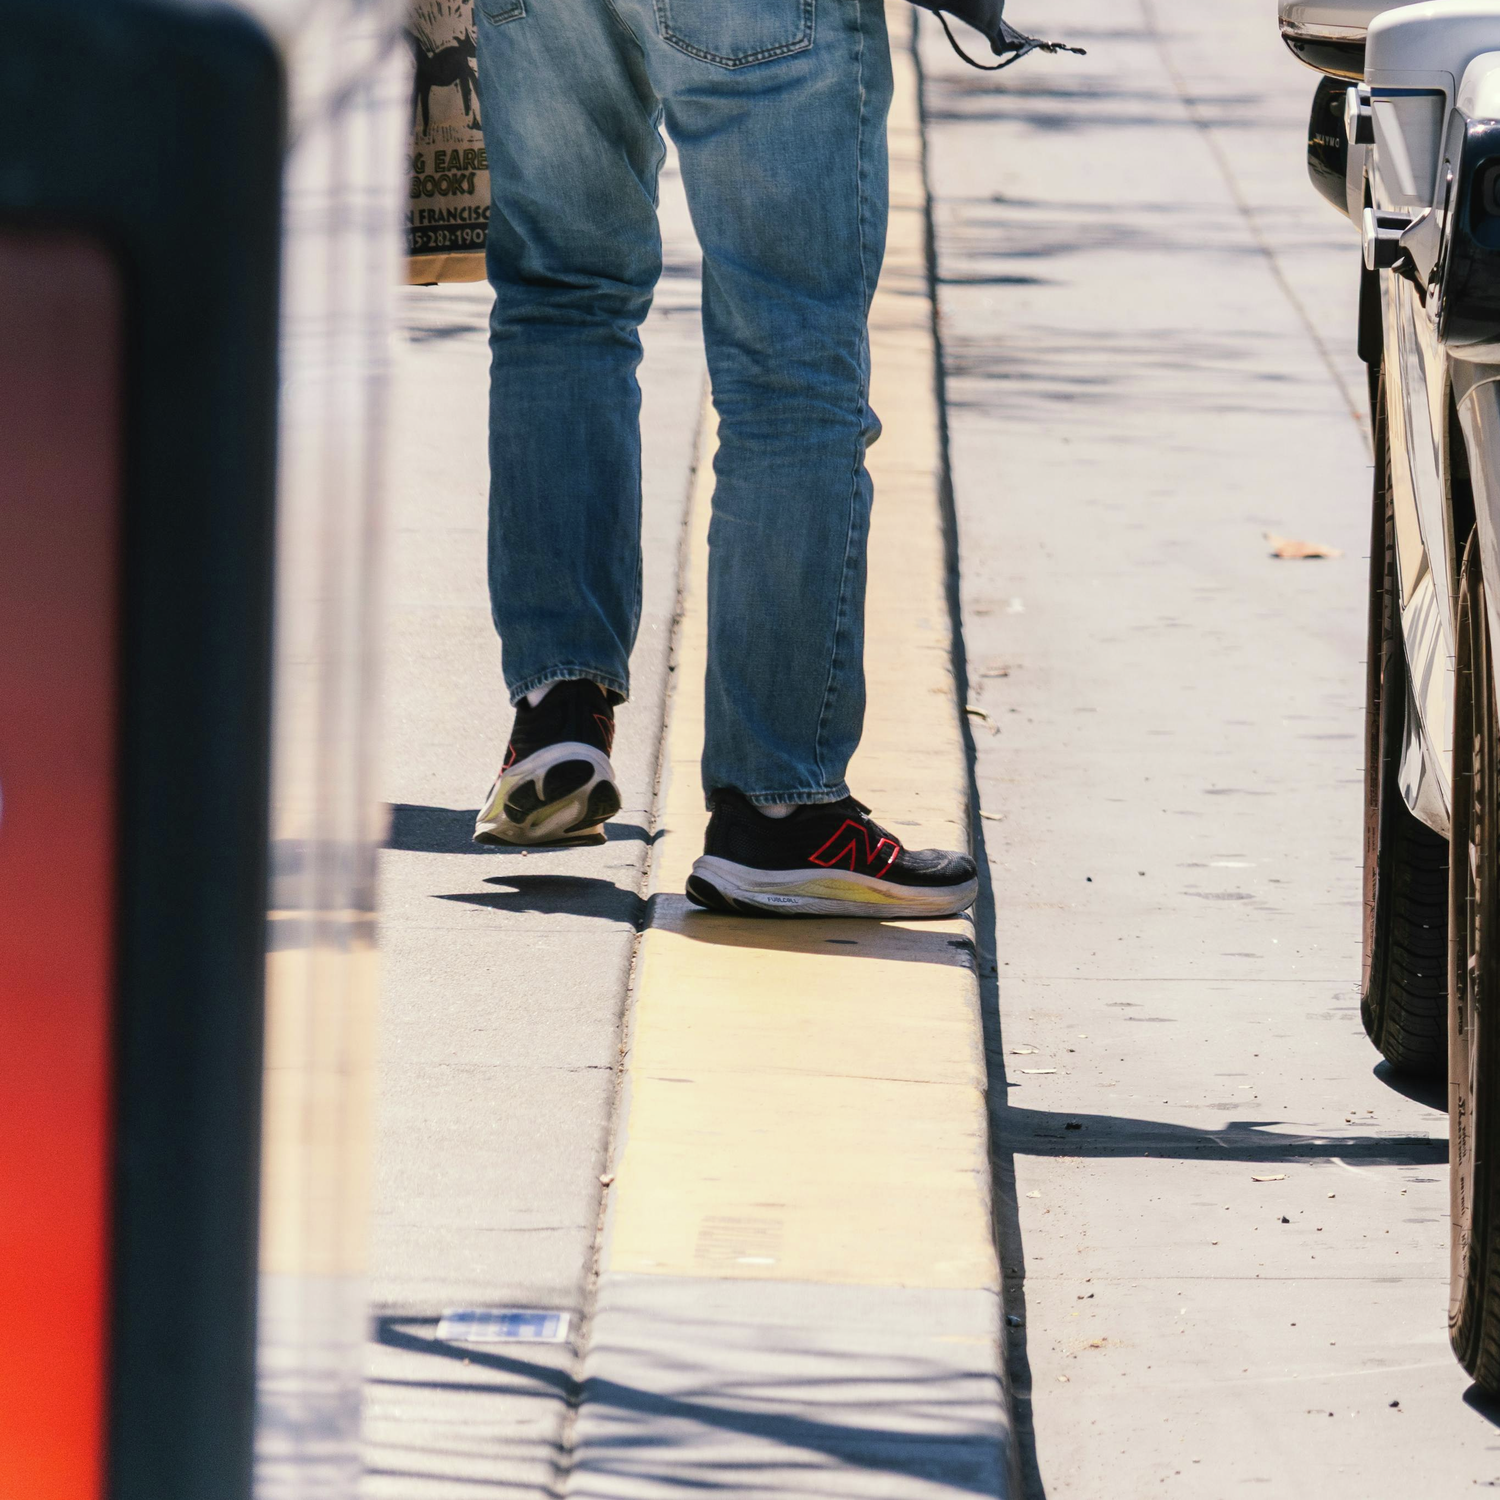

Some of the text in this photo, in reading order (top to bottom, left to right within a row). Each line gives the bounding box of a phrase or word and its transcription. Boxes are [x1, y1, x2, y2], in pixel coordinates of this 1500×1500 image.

[434, 148, 489, 173] EARE
[409, 172, 477, 199] BOOKS
[418, 205, 491, 225] FRANCISC
